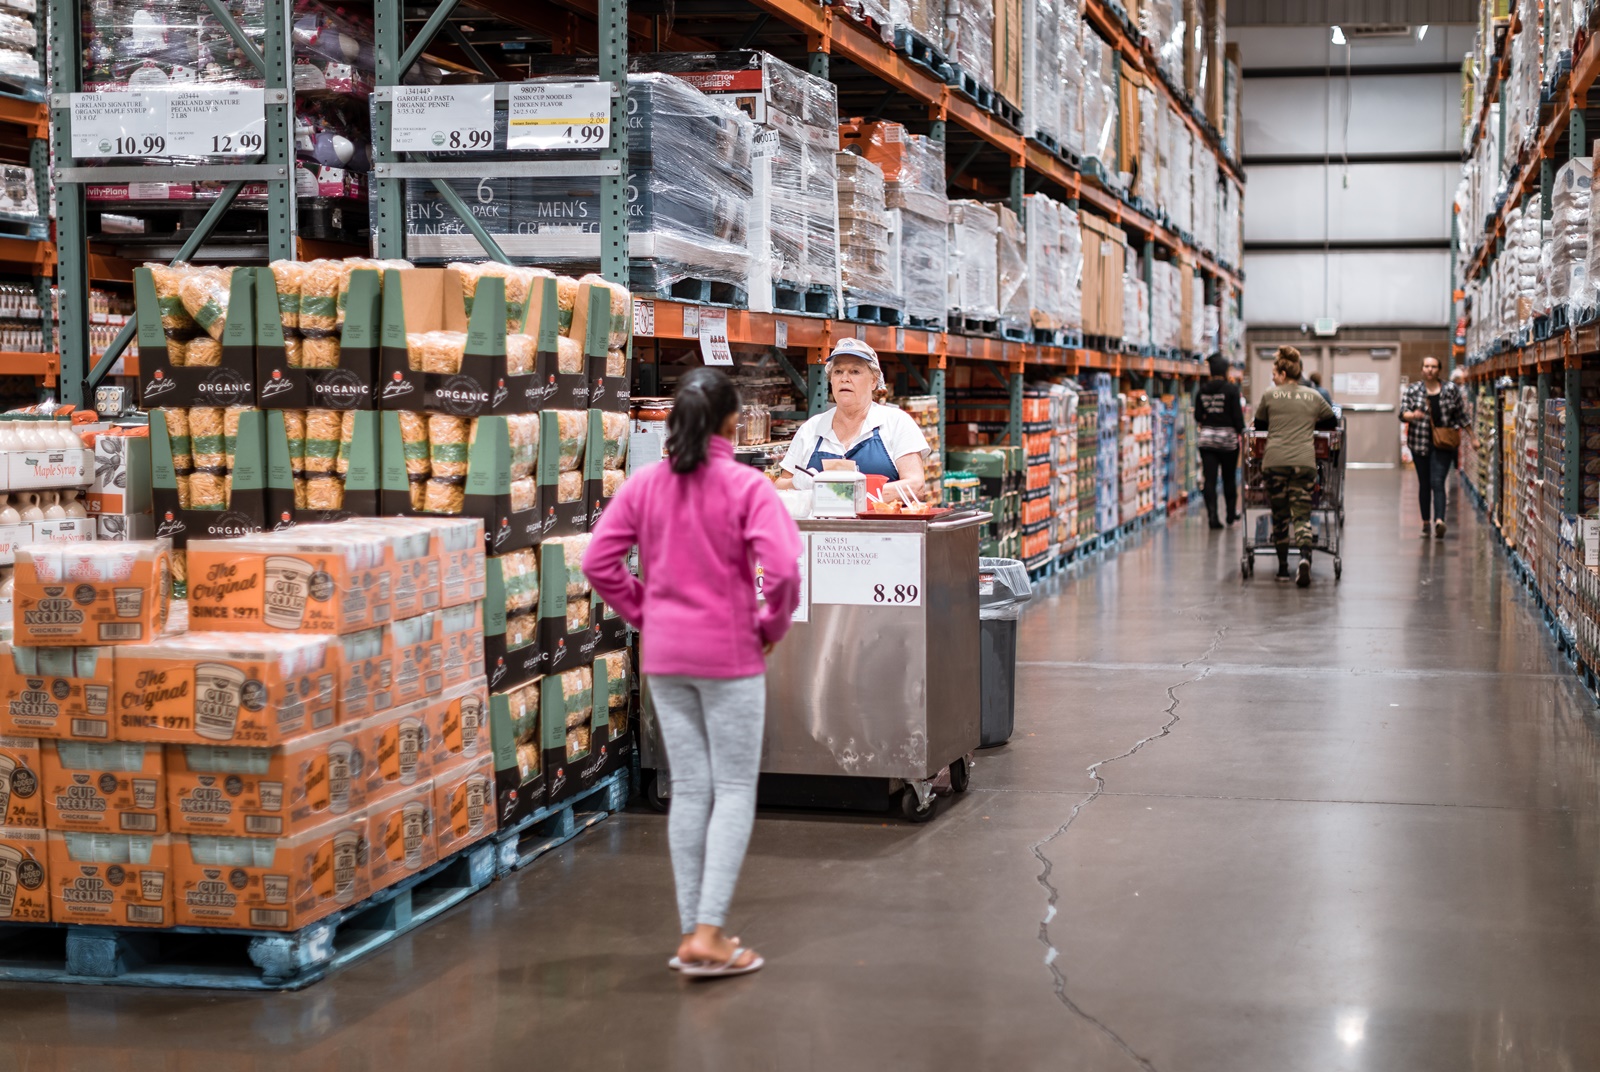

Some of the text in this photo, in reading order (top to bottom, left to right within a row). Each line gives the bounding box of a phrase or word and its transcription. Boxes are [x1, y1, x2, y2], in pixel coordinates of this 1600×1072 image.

[749, 54, 758, 66] 4
[449, 130, 492, 149] 8.99
[562, 125, 604, 144] 4.99
[115, 136, 166, 155] 10.99
[211, 134, 262, 153] 12.99
[477, 177, 494, 204] 6
[472, 205, 500, 217] PACK
[537, 200, 588, 218] MEN'S
[198, 383, 251, 393] ORGANIC
[315, 384, 369, 394] ORGANIC
[435, 389, 489, 402] ORGANIC
[34, 465, 77, 479] Maple Syrup
[208, 526, 262, 536] ORGANIC
[207, 564, 237, 581] The
[193, 573, 258, 603] Original
[275, 581, 302, 596] CUP
[873, 583, 918, 603] 8.89
[39, 599, 72, 612] CUP
[24, 610, 85, 625] NOODLES
[192, 606, 259, 619] SINCE 1971
[309, 610, 322, 618] 24
[304, 620, 335, 630] 2.5 OZ
[135, 669, 167, 688] The
[21, 691, 49, 703] CUP
[121, 680, 188, 711] Original
[204, 689, 234, 703] CUP
[9, 702, 60, 718] NOODLES
[121, 715, 190, 728] SINCE 1971
[242, 720, 255, 729] 24
[235, 731, 267, 741] 2.5 OZ
[17, 772, 26, 780] NO
[13, 779, 34, 787] ADDED
[67, 786, 96, 799] CUP
[192, 788, 222, 800] CUP
[13, 806, 26, 815] 24
[56, 797, 107, 812] NOODLES
[180, 798, 232, 814] NOODLES
[8, 817, 39, 826] 2.5 OZ
[74, 878, 104, 890] CUP
[198, 881, 227, 894] CUP
[20, 898, 32, 907] 24
[63, 889, 114, 904] NOODLES
[186, 892, 237, 908] NOODLES
[15, 909, 45, 918] 2.5 OZ
